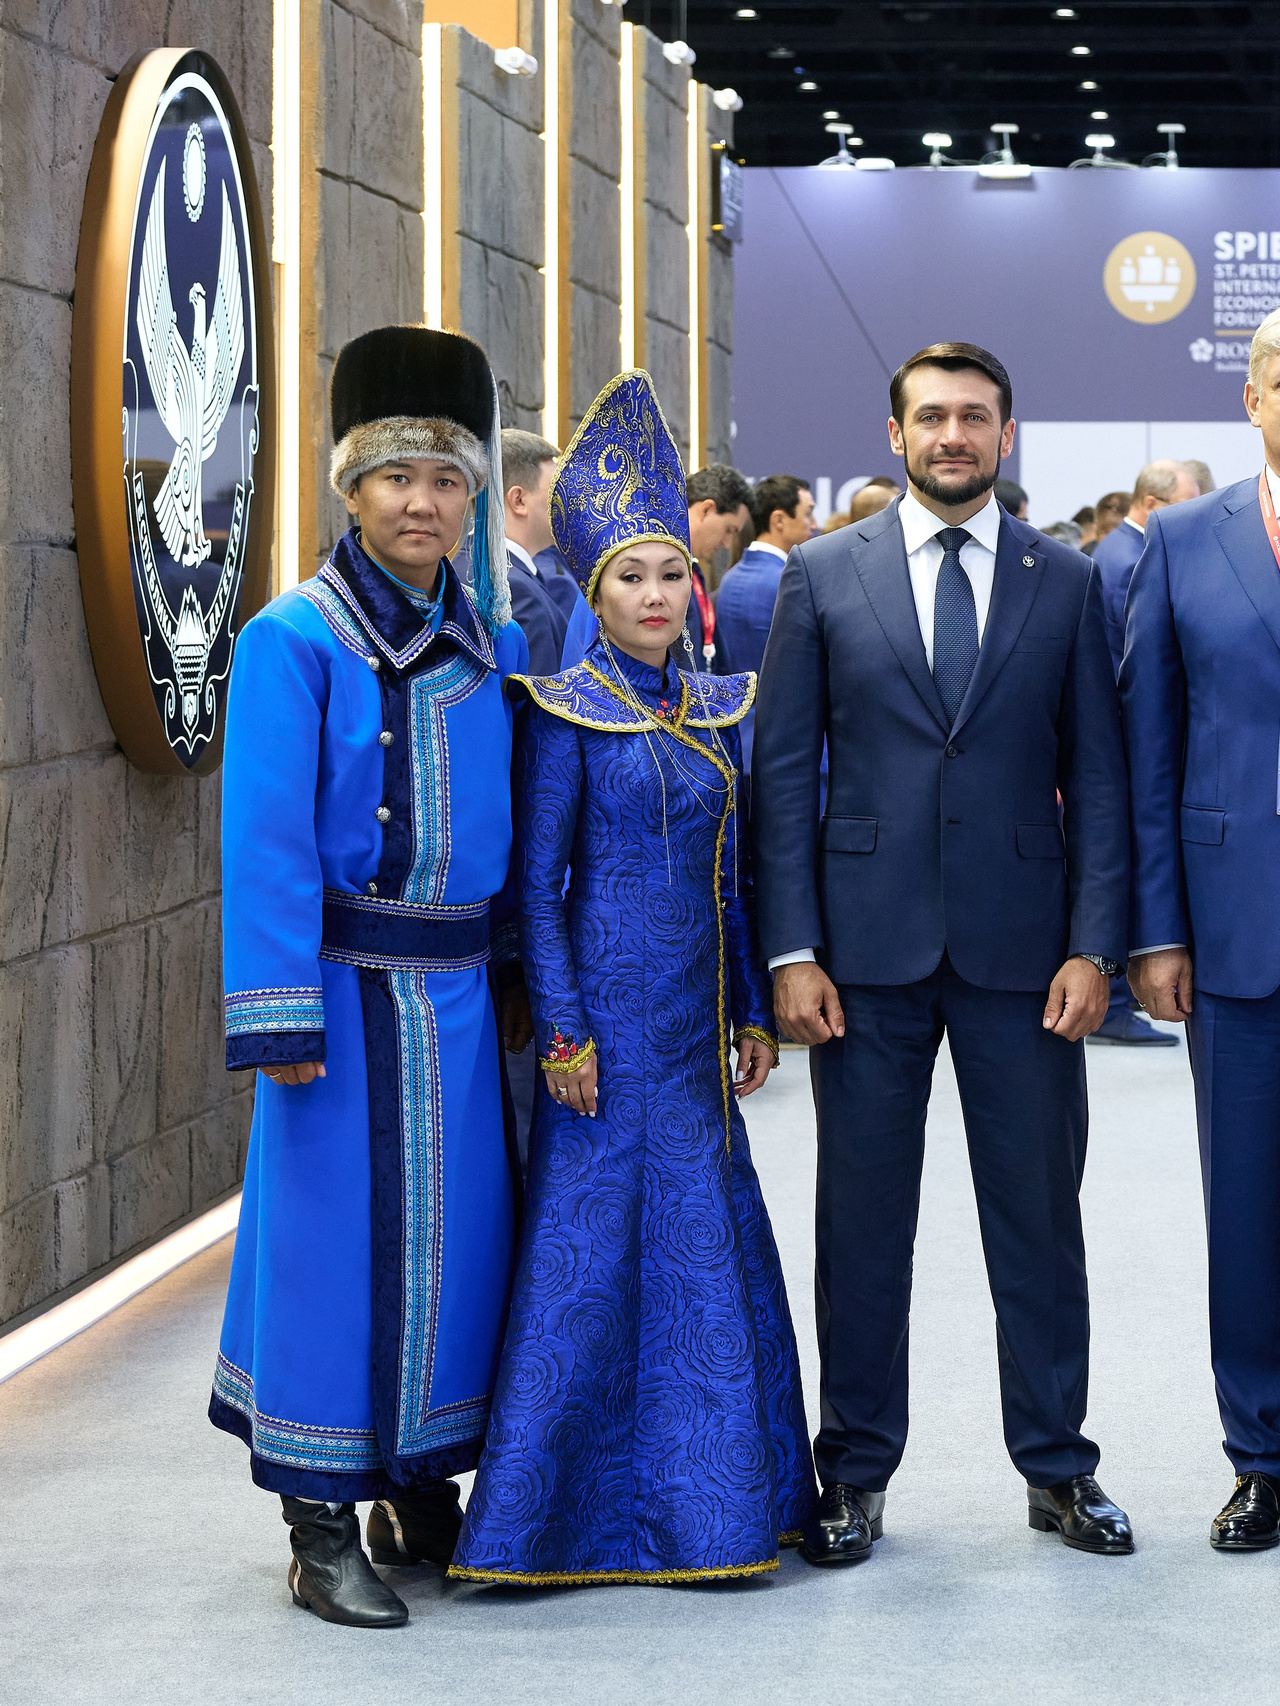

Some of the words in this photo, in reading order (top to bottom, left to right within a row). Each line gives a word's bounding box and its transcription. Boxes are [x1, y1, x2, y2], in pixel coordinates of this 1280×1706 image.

[1213, 264, 1238, 279] ST.
[1213, 312, 1267, 327] FORU
[135, 480, 172, 643] РЕСПУБЛИКА
[209, 496, 243, 641] ДАГЕСТАН
